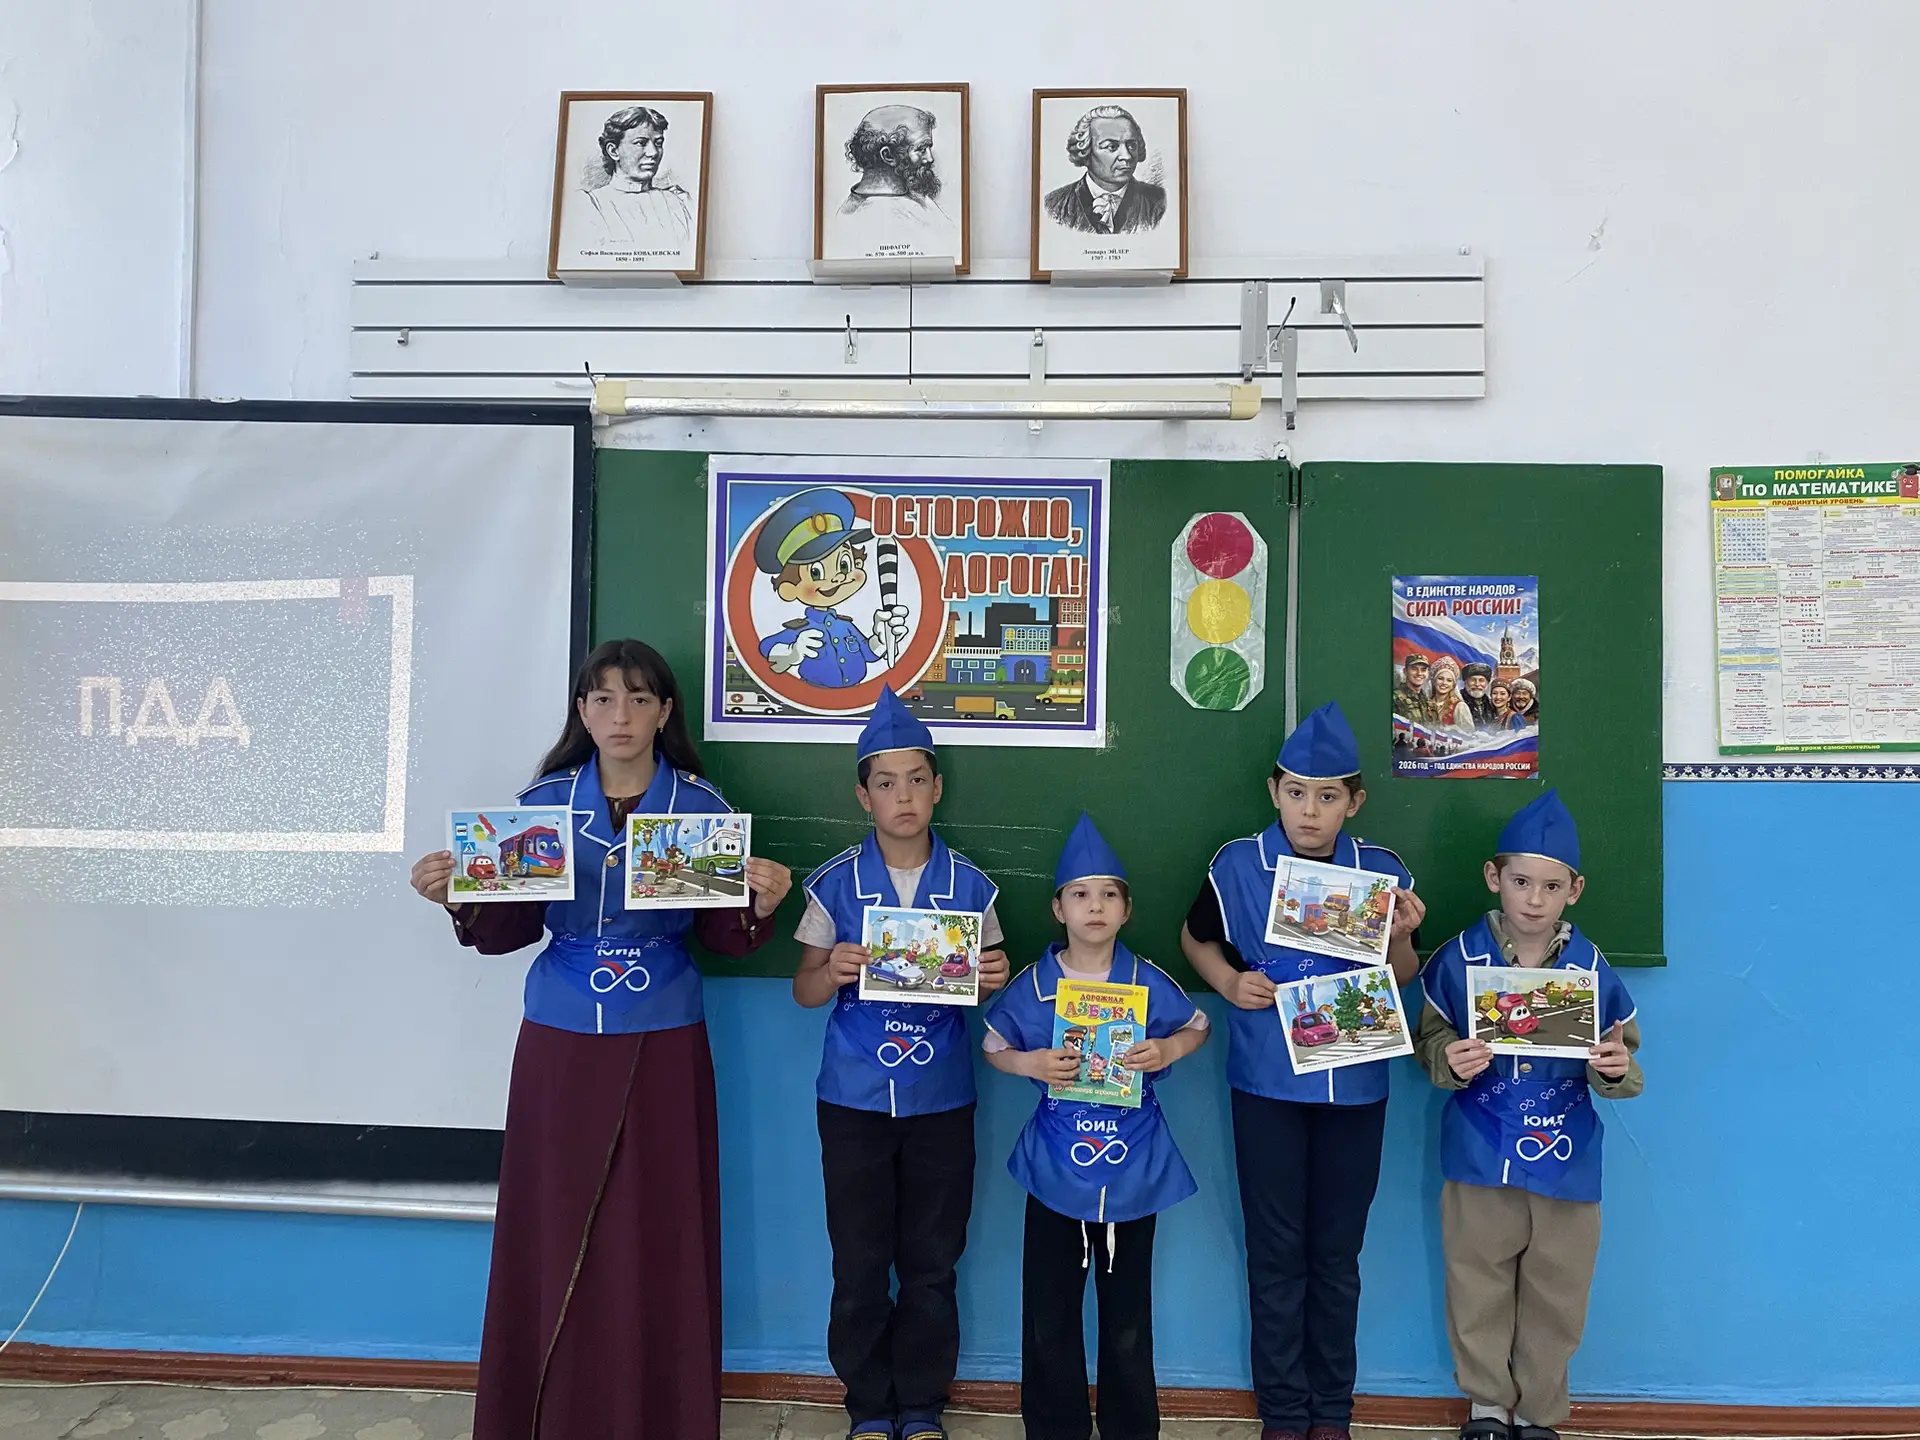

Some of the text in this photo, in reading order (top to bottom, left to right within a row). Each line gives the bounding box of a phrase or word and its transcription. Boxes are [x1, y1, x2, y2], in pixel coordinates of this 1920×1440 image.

[1774, 467, 1865, 480] ПОМОГАЙКА
[1742, 481, 1897, 497] ПО МАТЕМАТИКЕ
[872, 495, 1084, 544] ОСТОРОЖНО,
[943, 554, 1082, 600] ДОРОГА!
[1407, 587, 1413, 596] В
[1416, 585, 1466, 598] ЕДИНСТВЕ
[1469, 585, 1515, 596] НАРОДОВ
[1406, 599, 1521, 617] СИЛА РОССИИ!
[79, 675, 250, 748] ПДД
[1399, 761, 1416, 769] 2026
[1080, 994, 1124, 1004] ДОРОЖНАЯ
[1064, 1001, 1137, 1024] АЗБУКА
[885, 1020, 926, 1033] ЮИД
[1076, 1120, 1118, 1132] ЮИД
[1524, 1114, 1565, 1126] ЮИД
